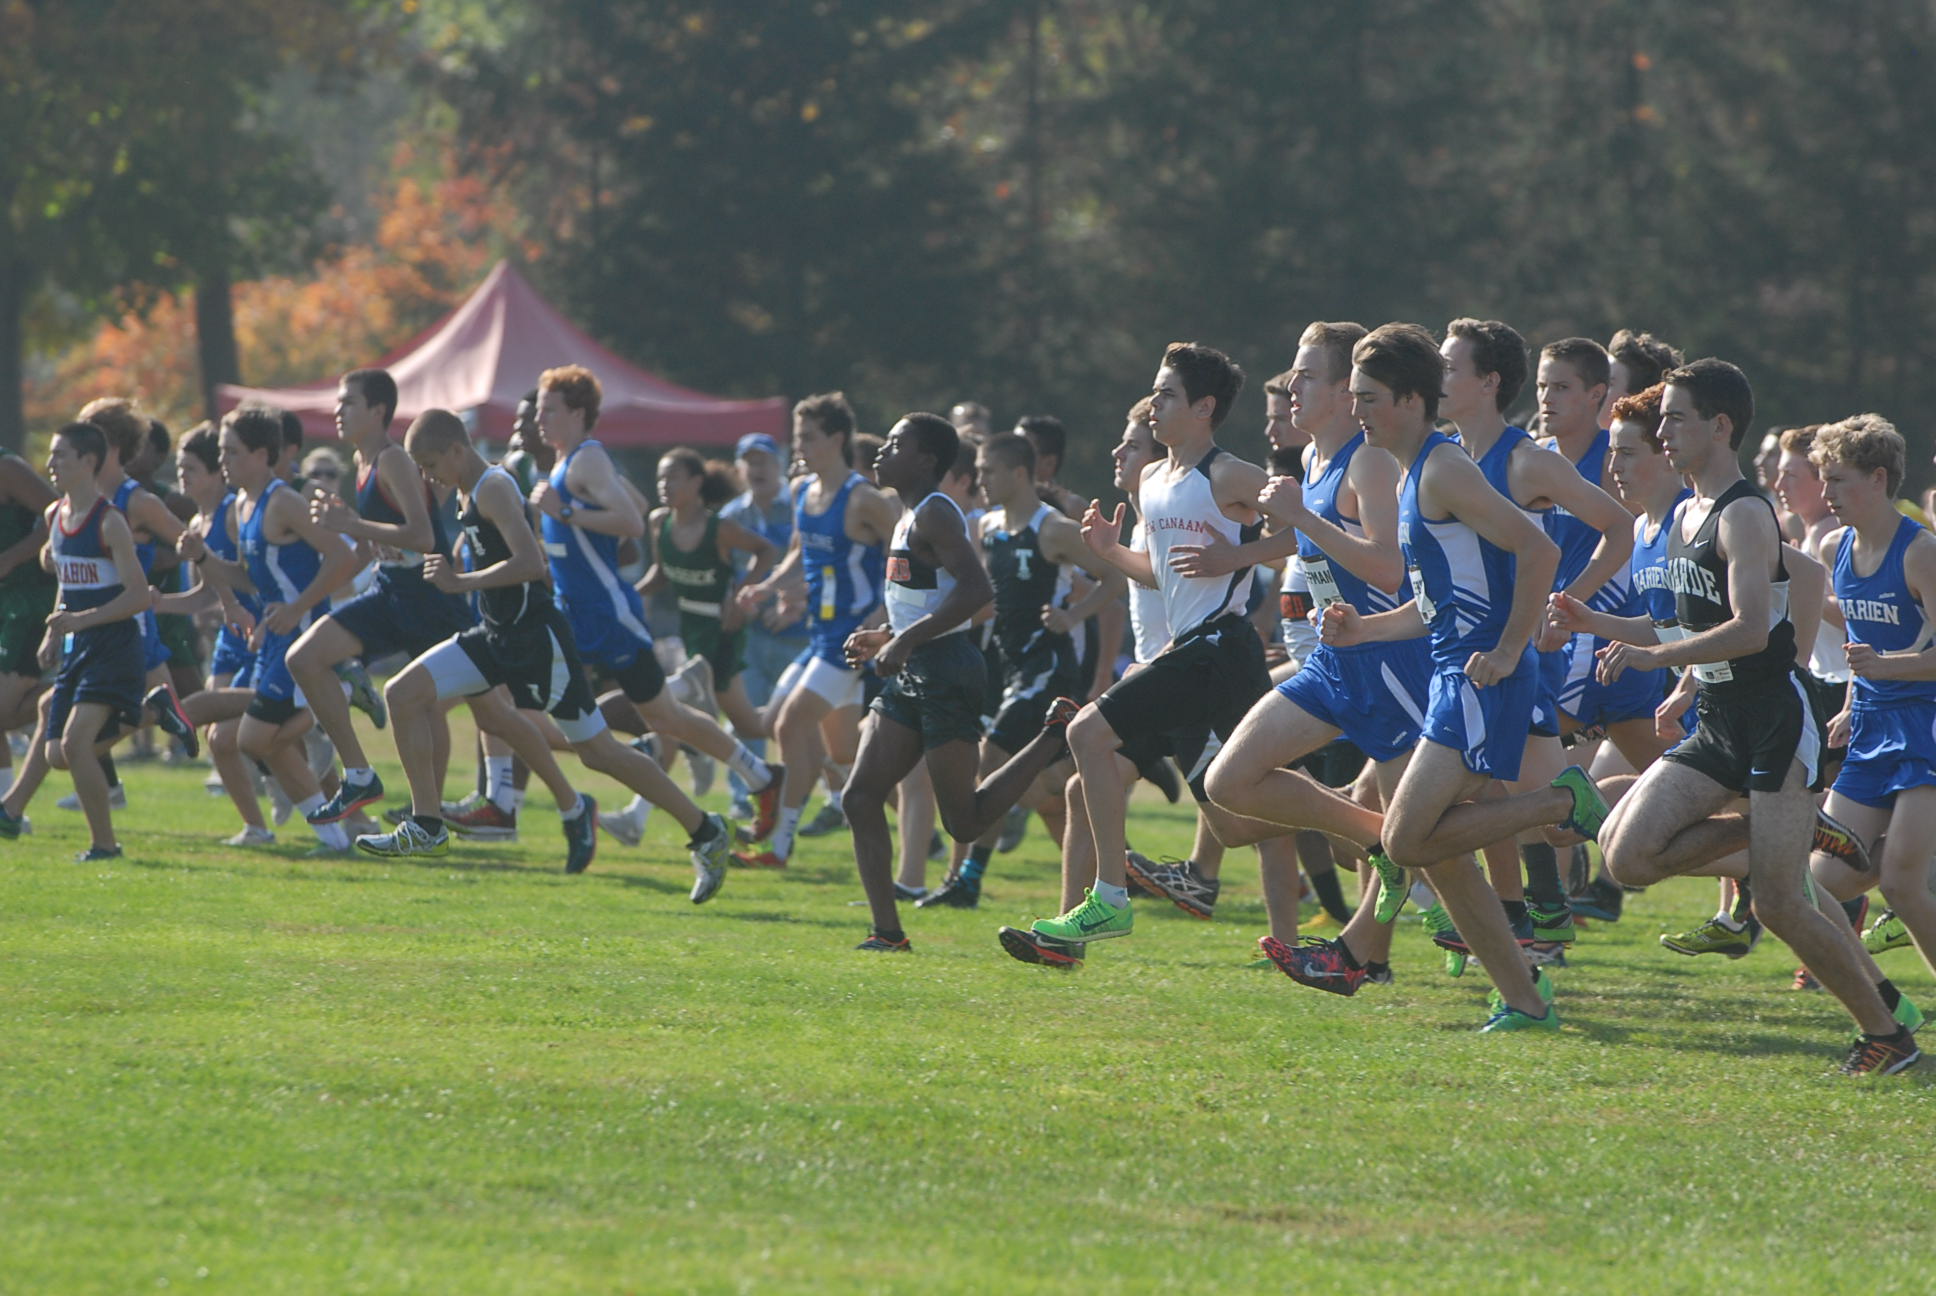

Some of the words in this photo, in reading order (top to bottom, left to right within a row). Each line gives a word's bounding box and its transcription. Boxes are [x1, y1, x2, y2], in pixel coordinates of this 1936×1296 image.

[1159, 517, 1204, 534] CANAAN
[1015, 548, 1033, 580] T
[1633, 566, 1675, 596] DARIEN
[1838, 599, 1900, 626] DARIEN
